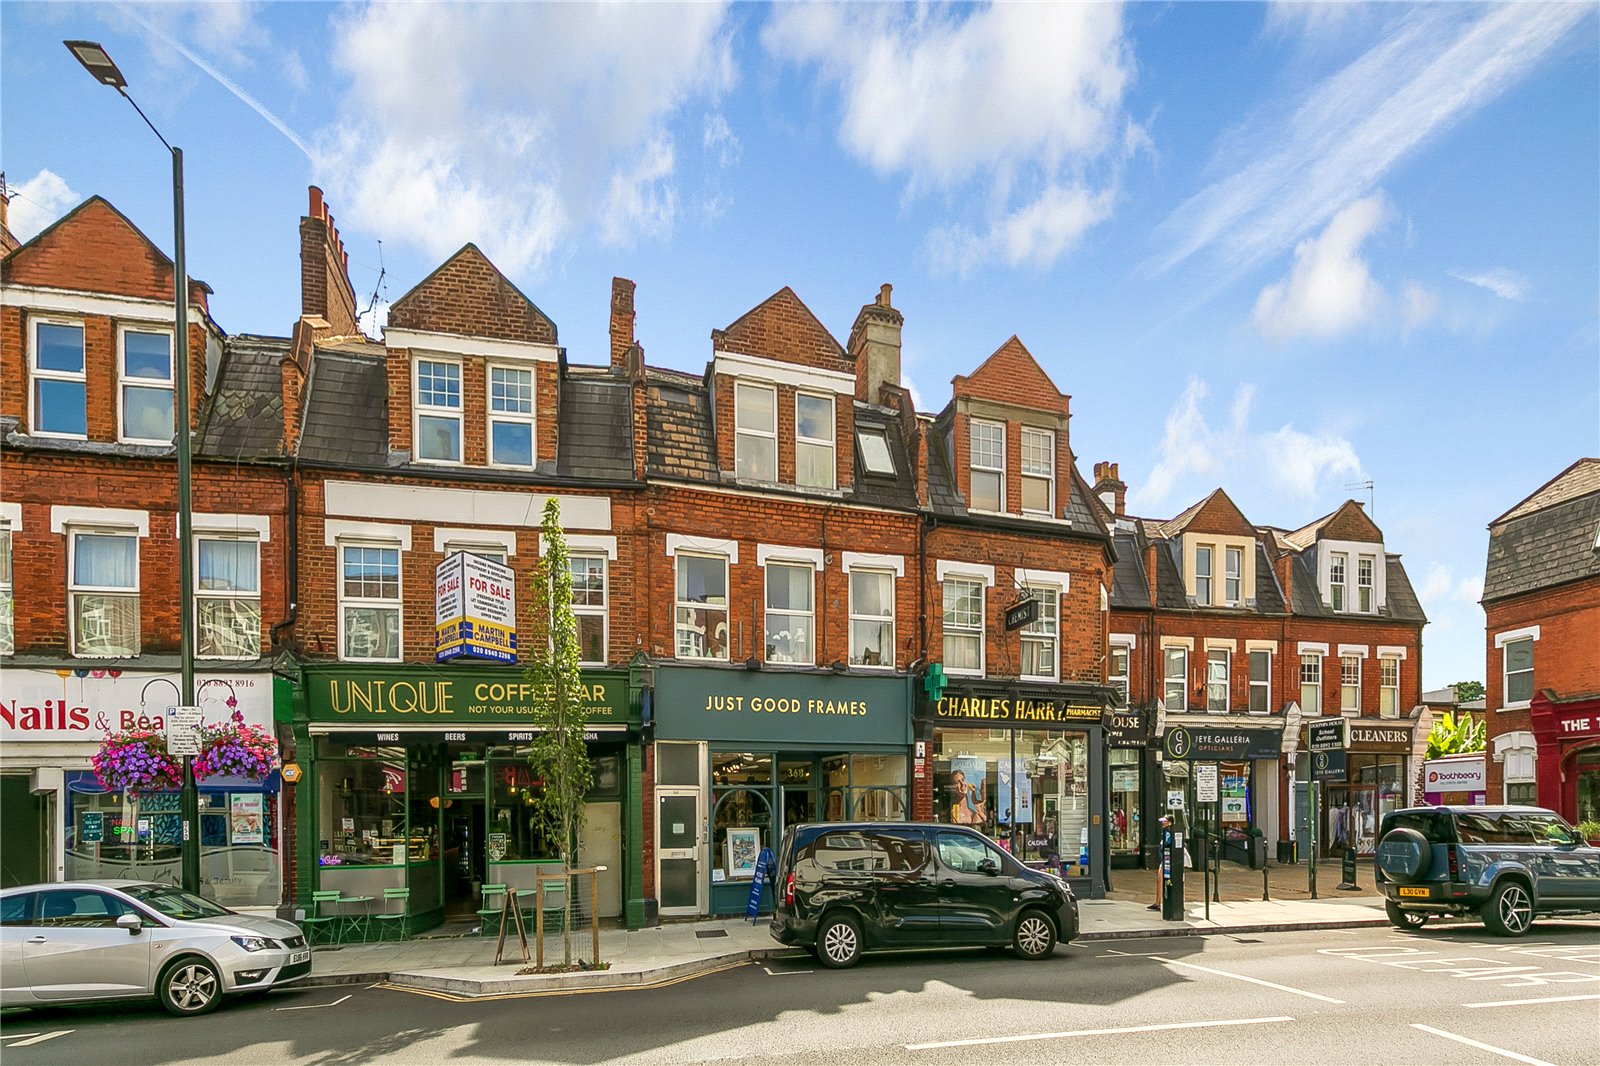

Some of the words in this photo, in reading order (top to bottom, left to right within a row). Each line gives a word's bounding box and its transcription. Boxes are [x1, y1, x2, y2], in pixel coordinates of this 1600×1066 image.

[447, 576, 460, 592] SALE
[470, 577, 488, 593] FOR
[490, 584, 511, 600] SALE
[478, 624, 505, 638] MARTIN
[474, 632, 510, 648] CAMPBELL
[330, 680, 454, 714] UNIQUE
[580, 706, 612, 714] COFFEE
[706, 696, 744, 711] JUST
[750, 698, 800, 713] GOOD
[808, 700, 867, 716] FRAMES
[937, 697, 1010, 719] CHARLES
[1066, 708, 1101, 717] PHARMACIST
[0, 700, 90, 731] Nails
[94, 711, 110, 731] &
[1112, 716, 1140, 728] OUSE
[1561, 718, 1590, 732] THE
[377, 733, 399, 741] WINES
[445, 732, 466, 741] BEERS
[508, 732, 533, 741] SPIRITS
[1214, 736, 1250, 744] GALLERIA
[1350, 730, 1408, 742] CLEANERS
[1438, 772, 1482, 780] Toothbeary
[114, 826, 134, 834] SPA
